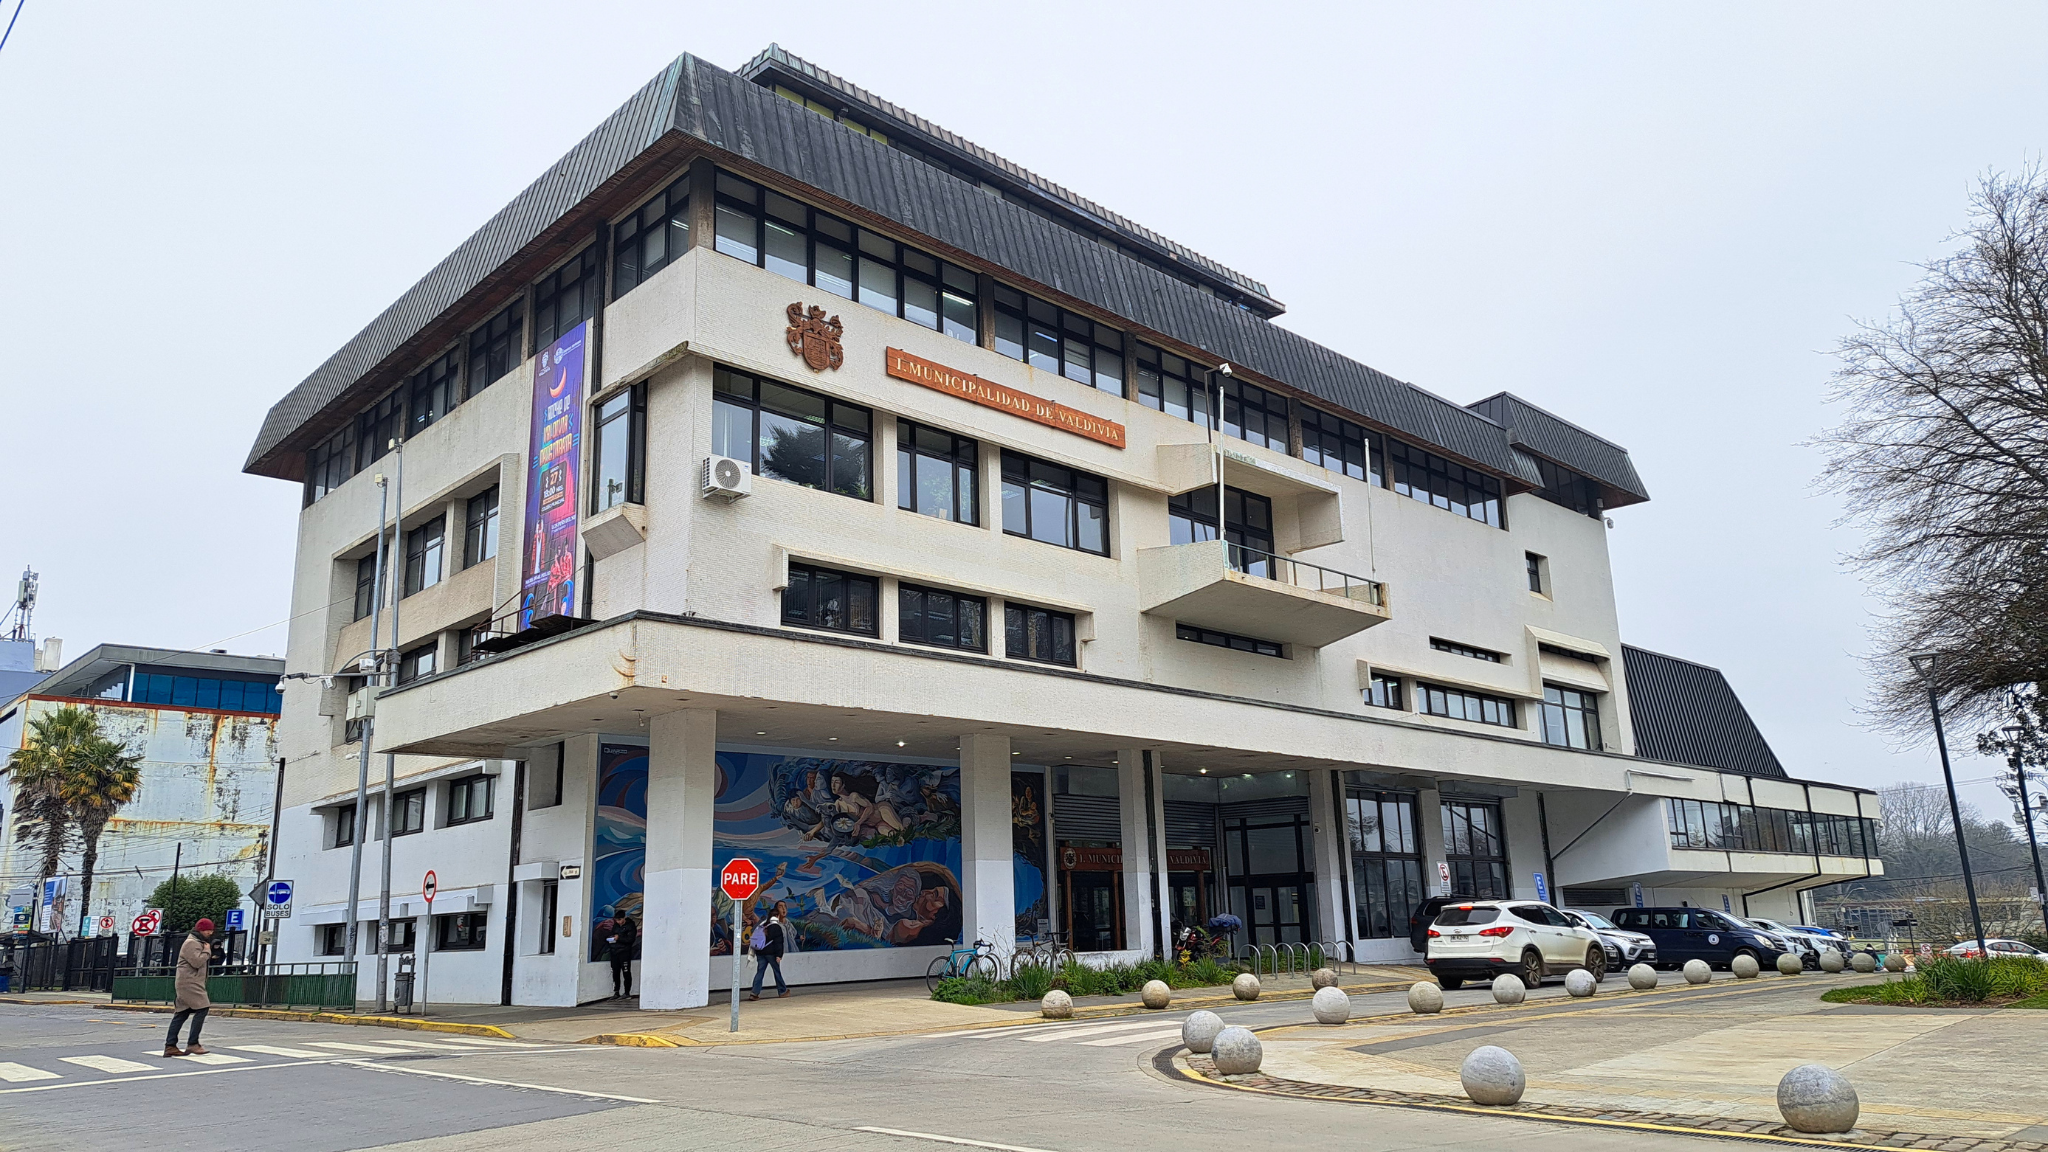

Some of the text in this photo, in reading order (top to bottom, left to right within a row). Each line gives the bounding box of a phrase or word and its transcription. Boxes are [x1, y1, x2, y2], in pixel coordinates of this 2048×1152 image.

[1036, 403, 1053, 419] DE
[1059, 410, 1118, 440] VALDIVIA
[550, 471, 558, 485] 27
[1089, 854, 1123, 864] MUNICI
[1170, 855, 1207, 865] VALDIVIA
[724, 872, 757, 885] PARE
[231, 912, 240, 923] E
